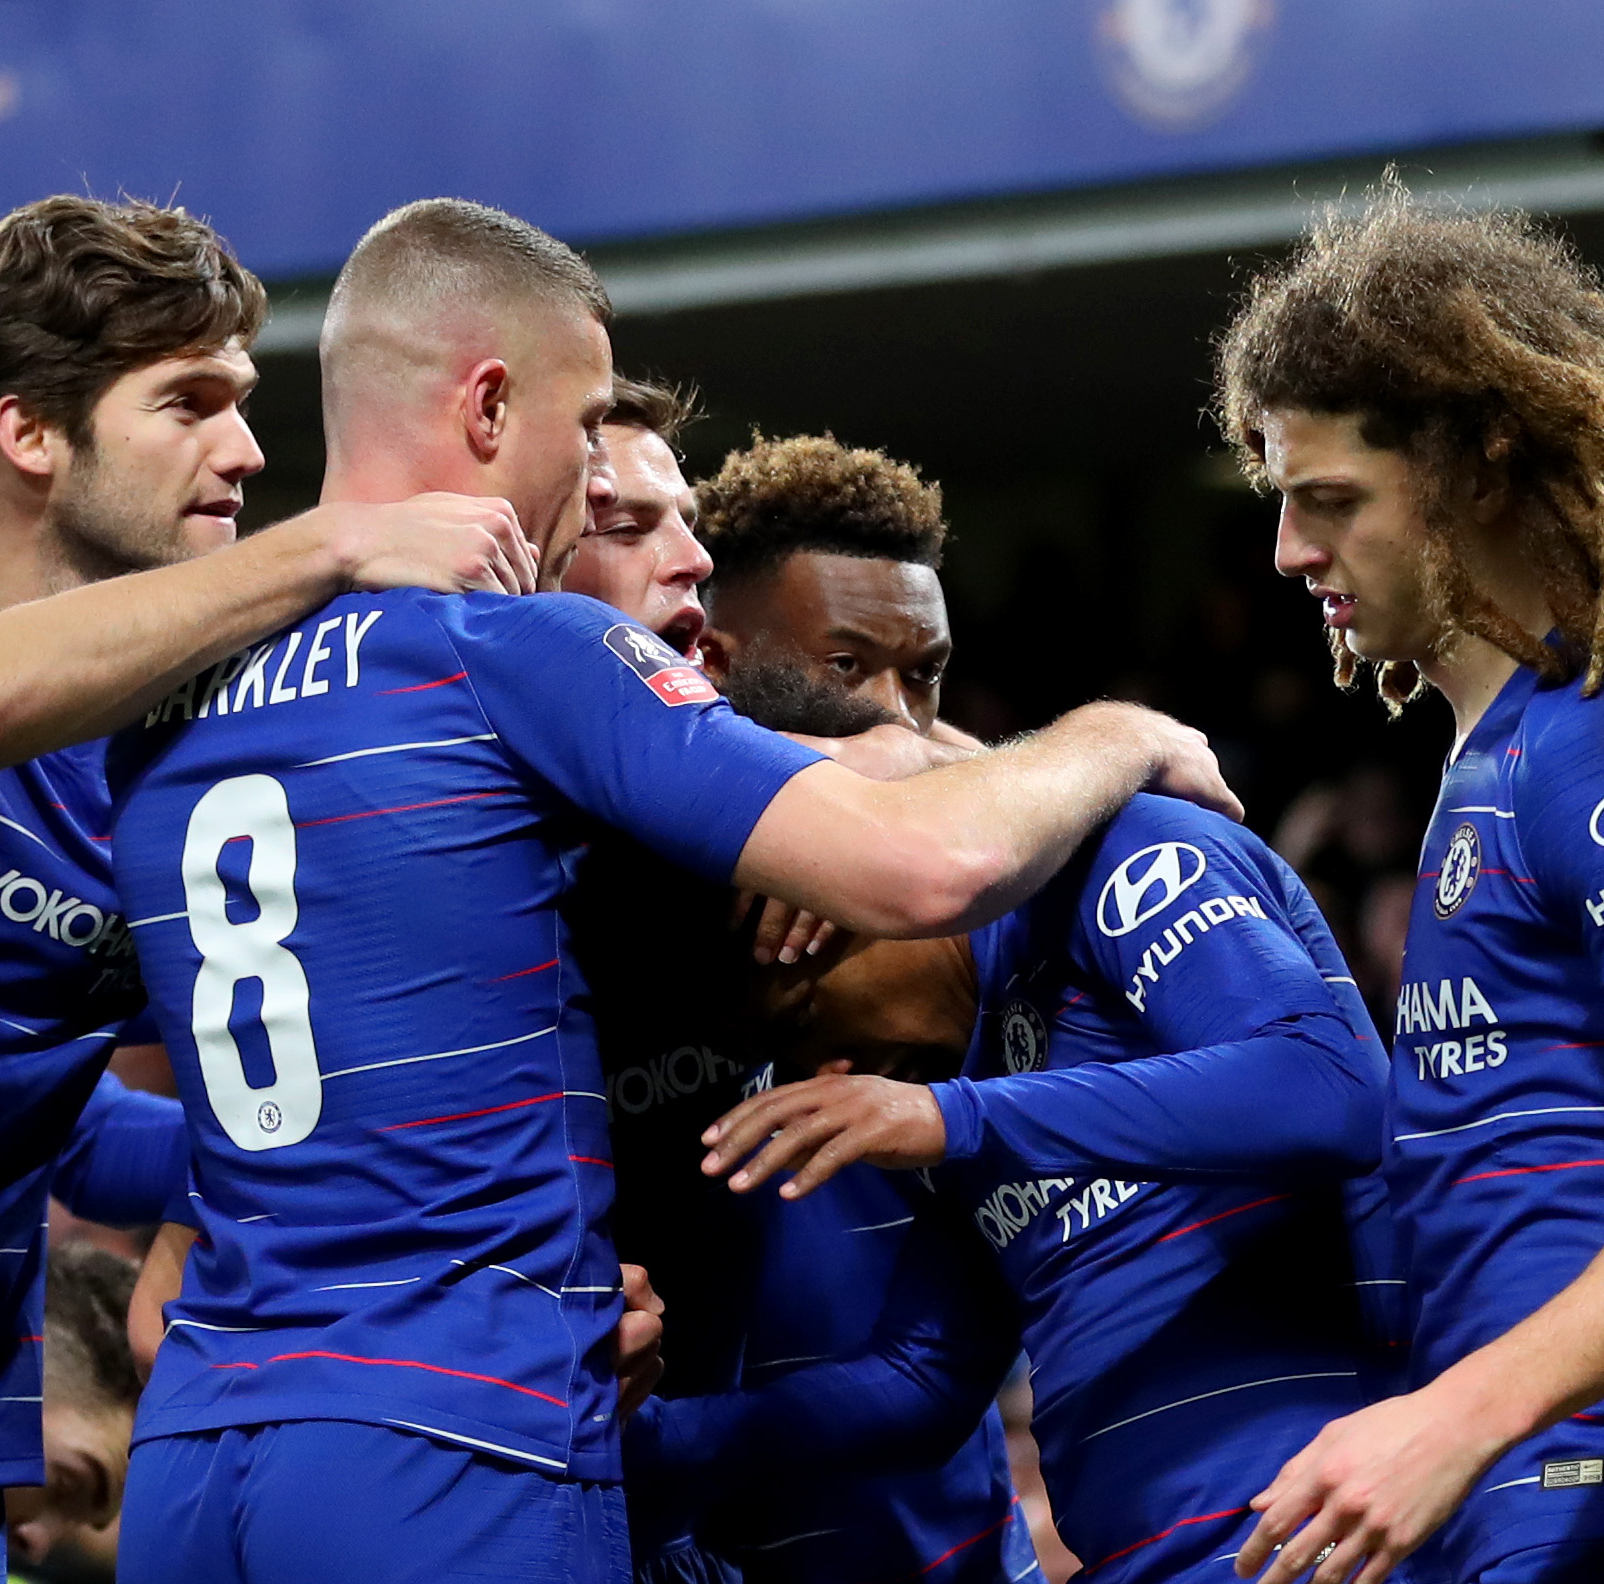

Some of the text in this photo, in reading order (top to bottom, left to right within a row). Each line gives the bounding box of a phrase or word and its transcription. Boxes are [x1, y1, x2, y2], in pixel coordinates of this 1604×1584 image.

[145, 610, 383, 729] ARKLEY
[181, 773, 323, 1152] 8
[1125, 895, 1270, 1013] HYUNDAI
[1413, 1030, 1509, 1081] TYRES
[1055, 1177, 1148, 1243] TYRE
